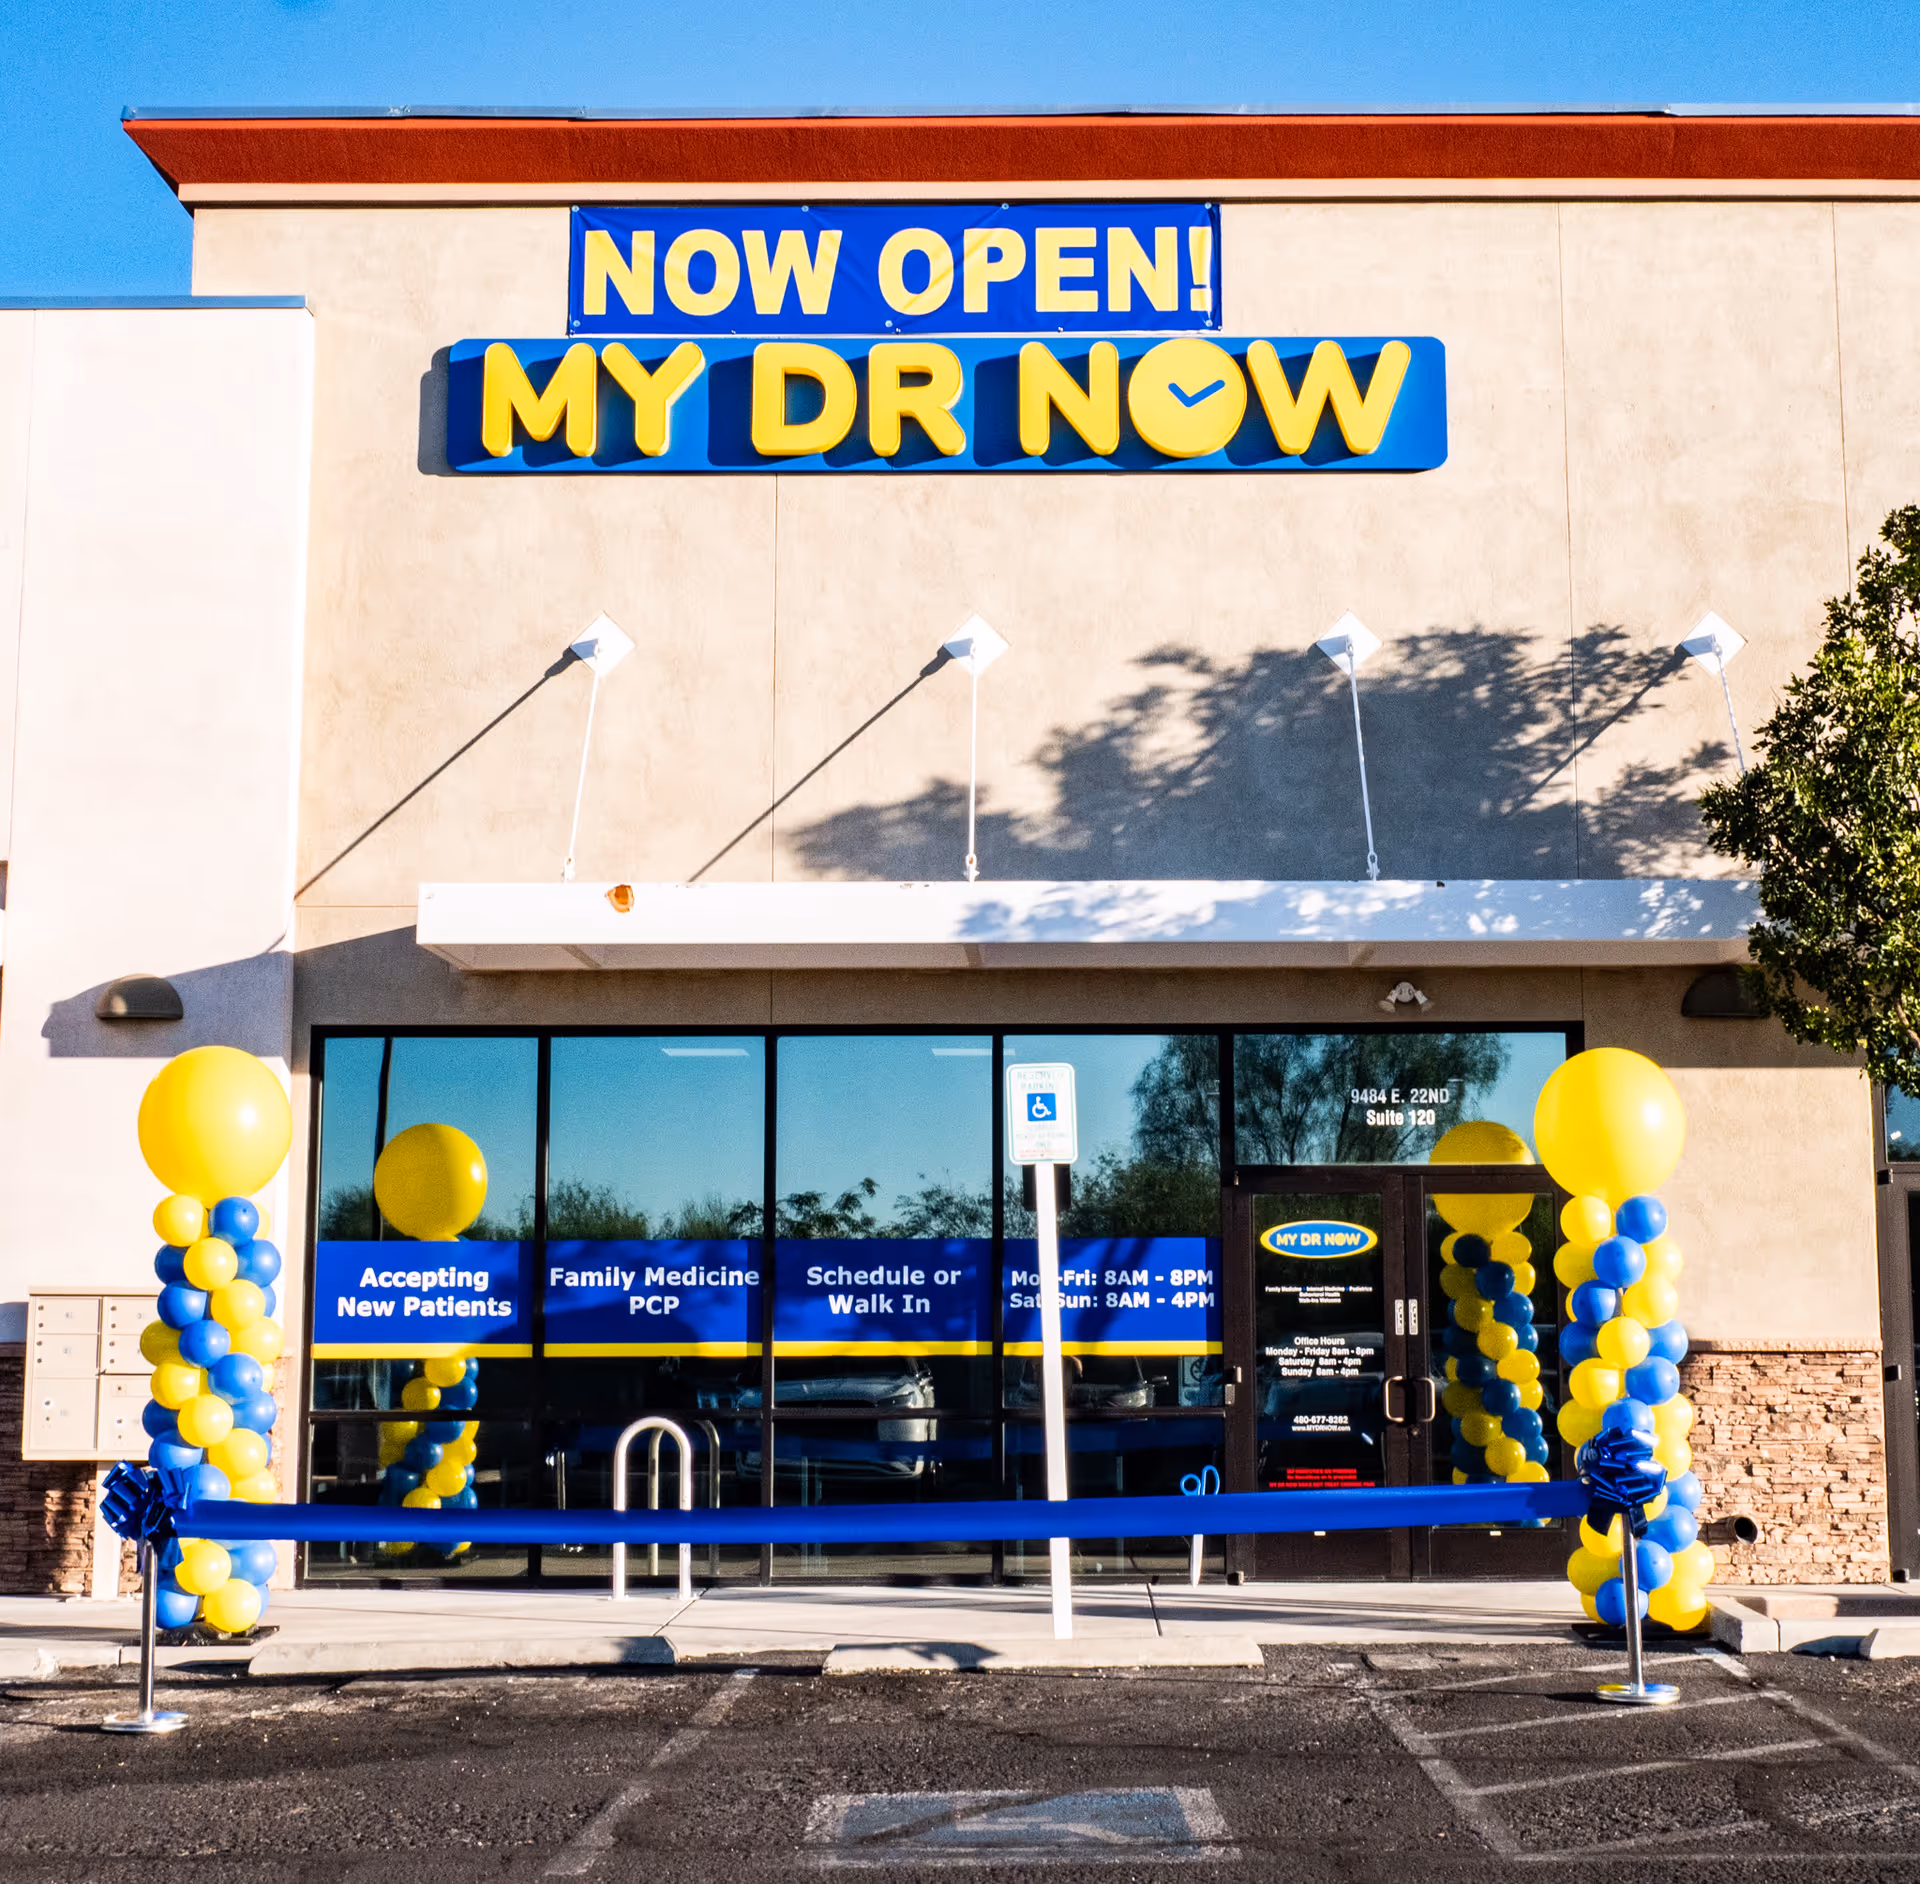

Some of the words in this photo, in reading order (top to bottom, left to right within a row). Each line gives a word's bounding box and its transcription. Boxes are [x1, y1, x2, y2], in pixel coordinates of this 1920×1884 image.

[582, 228, 843, 316] NOW
[878, 226, 1213, 316] OPEN!
[481, 342, 705, 458] MY
[750, 342, 967, 458] DR
[1018, 337, 1411, 459] NOW
[1351, 1088, 1387, 1104] 9484
[1391, 1088, 1405, 1104] E.
[1410, 1088, 1450, 1104] 22ND
[1366, 1109, 1405, 1126] Suite
[1408, 1109, 1436, 1126] 120
[1276, 1233, 1298, 1246] MY
[1300, 1233, 1322, 1246] DR
[1324, 1233, 1361, 1246] NOW
[359, 1267, 490, 1292] Accepting
[550, 1267, 635, 1290] Family
[644, 1266, 760, 1287] Medicine
[806, 1266, 924, 1286] Schedule
[933, 1270, 962, 1286] or
[1011, 1269, 1097, 1287] Mo-Fri:
[1104, 1269, 1149, 1287] 8AM
[1169, 1269, 1214, 1287] 8PM
[337, 1296, 395, 1317] New
[403, 1296, 512, 1317] Patients
[629, 1295, 680, 1315] PCP
[828, 1293, 894, 1315] Walk
[902, 1294, 931, 1314] In
[1010, 1292, 1098, 1309] SatSun:
[1106, 1291, 1150, 1309] 8AM
[1170, 1291, 1215, 1309] 4PM
[1294, 1337, 1319, 1346] Office
[1320, 1337, 1346, 1346] Hours
[1265, 1347, 1298, 1357] Monday
[1304, 1347, 1330, 1357] Friday
[1331, 1347, 1350, 1355] 8am
[1355, 1347, 1375, 1357] 8pm
[1279, 1357, 1316, 1367] Saturday
[1319, 1357, 1337, 1366] 8am
[1343, 1357, 1362, 1367] 4pm
[1281, 1367, 1313, 1378] Sunday
[1316, 1367, 1334, 1376] 8am
[1340, 1367, 1360, 1377] 4pm
[1293, 1415, 1349, 1424] 480-677-8282
